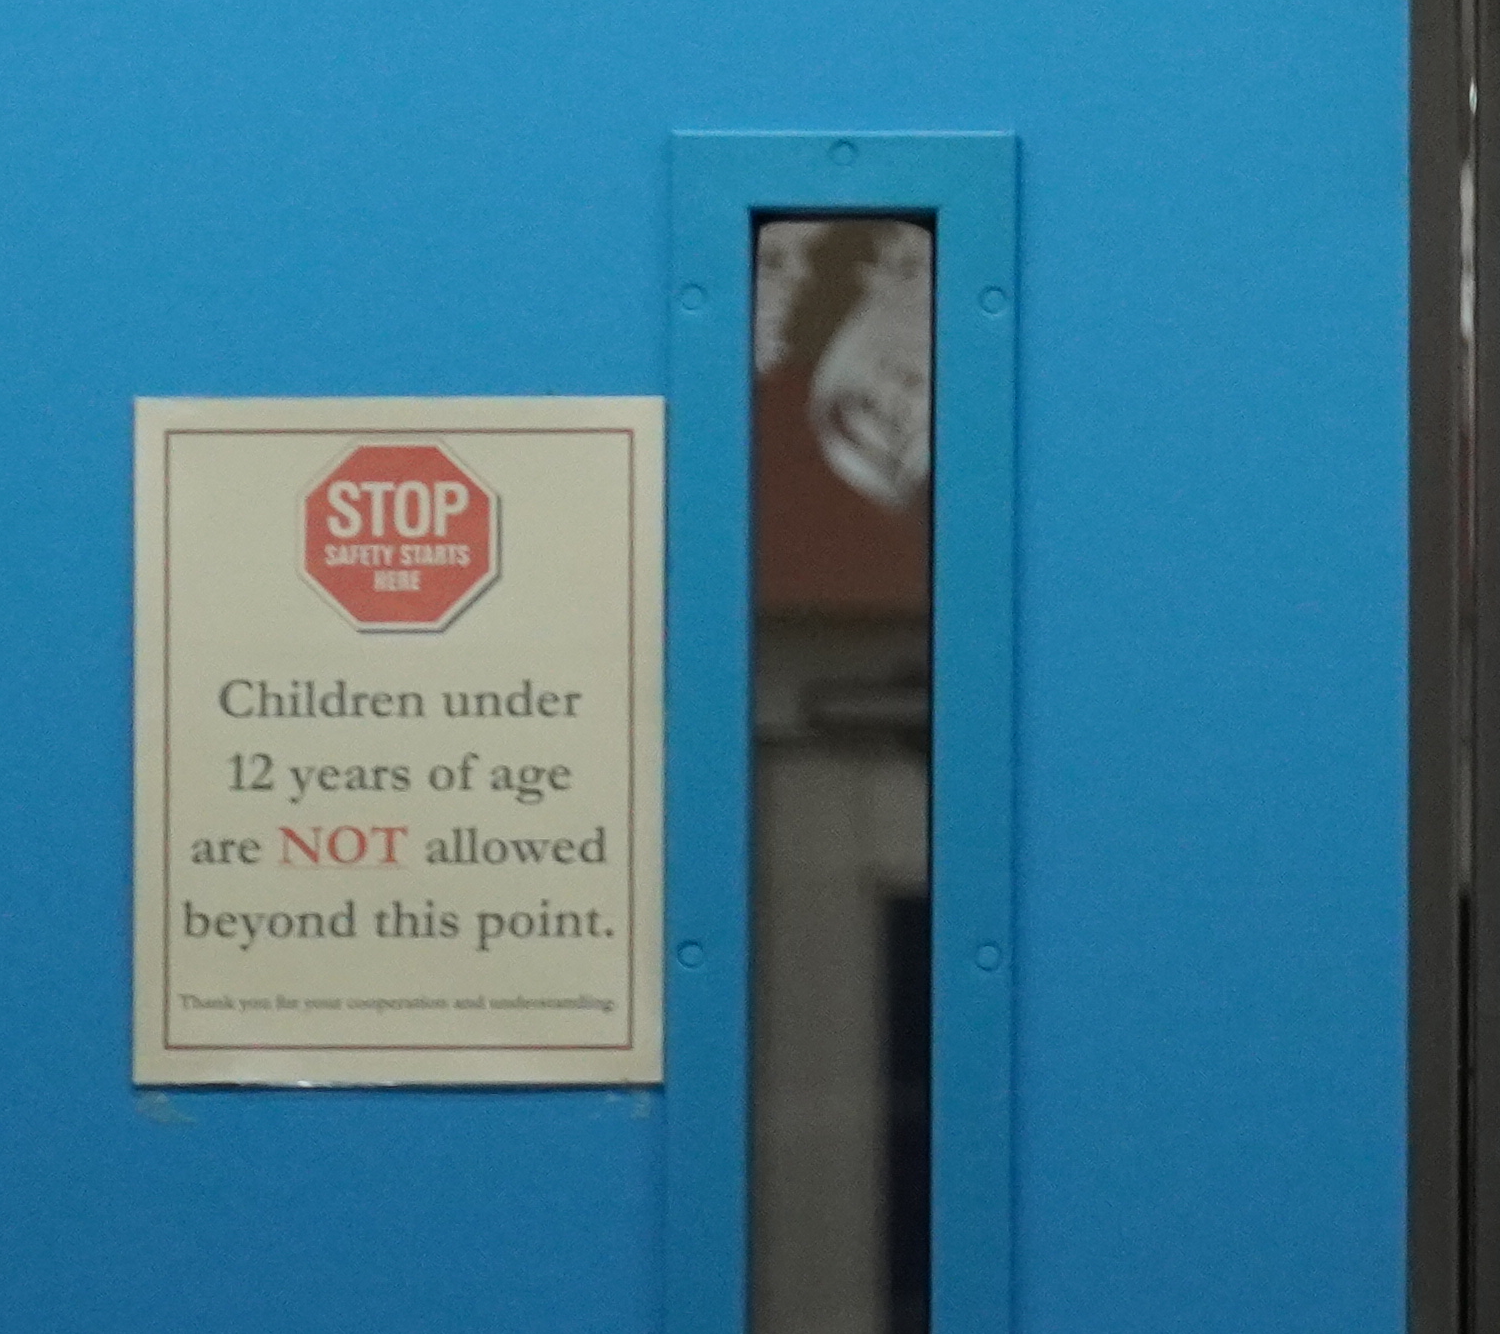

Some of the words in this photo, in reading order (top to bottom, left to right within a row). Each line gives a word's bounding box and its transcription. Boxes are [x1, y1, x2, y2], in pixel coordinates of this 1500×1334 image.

[323, 477, 471, 538] STOP
[325, 544, 394, 566] SAFETY
[400, 544, 470, 566] STARTS
[374, 570, 420, 591] HERE
[218, 679, 424, 718] Children
[443, 679, 582, 718] under
[230, 753, 274, 792] 12
[290, 766, 411, 804] years
[428, 752, 479, 791] of
[491, 765, 571, 805] age
[192, 839, 261, 864] are
[279, 827, 407, 864] NOT
[426, 826, 606, 865] allowed
[184, 899, 356, 951] beyond
[375, 900, 459, 938] this
[477, 899, 614, 952] point.
